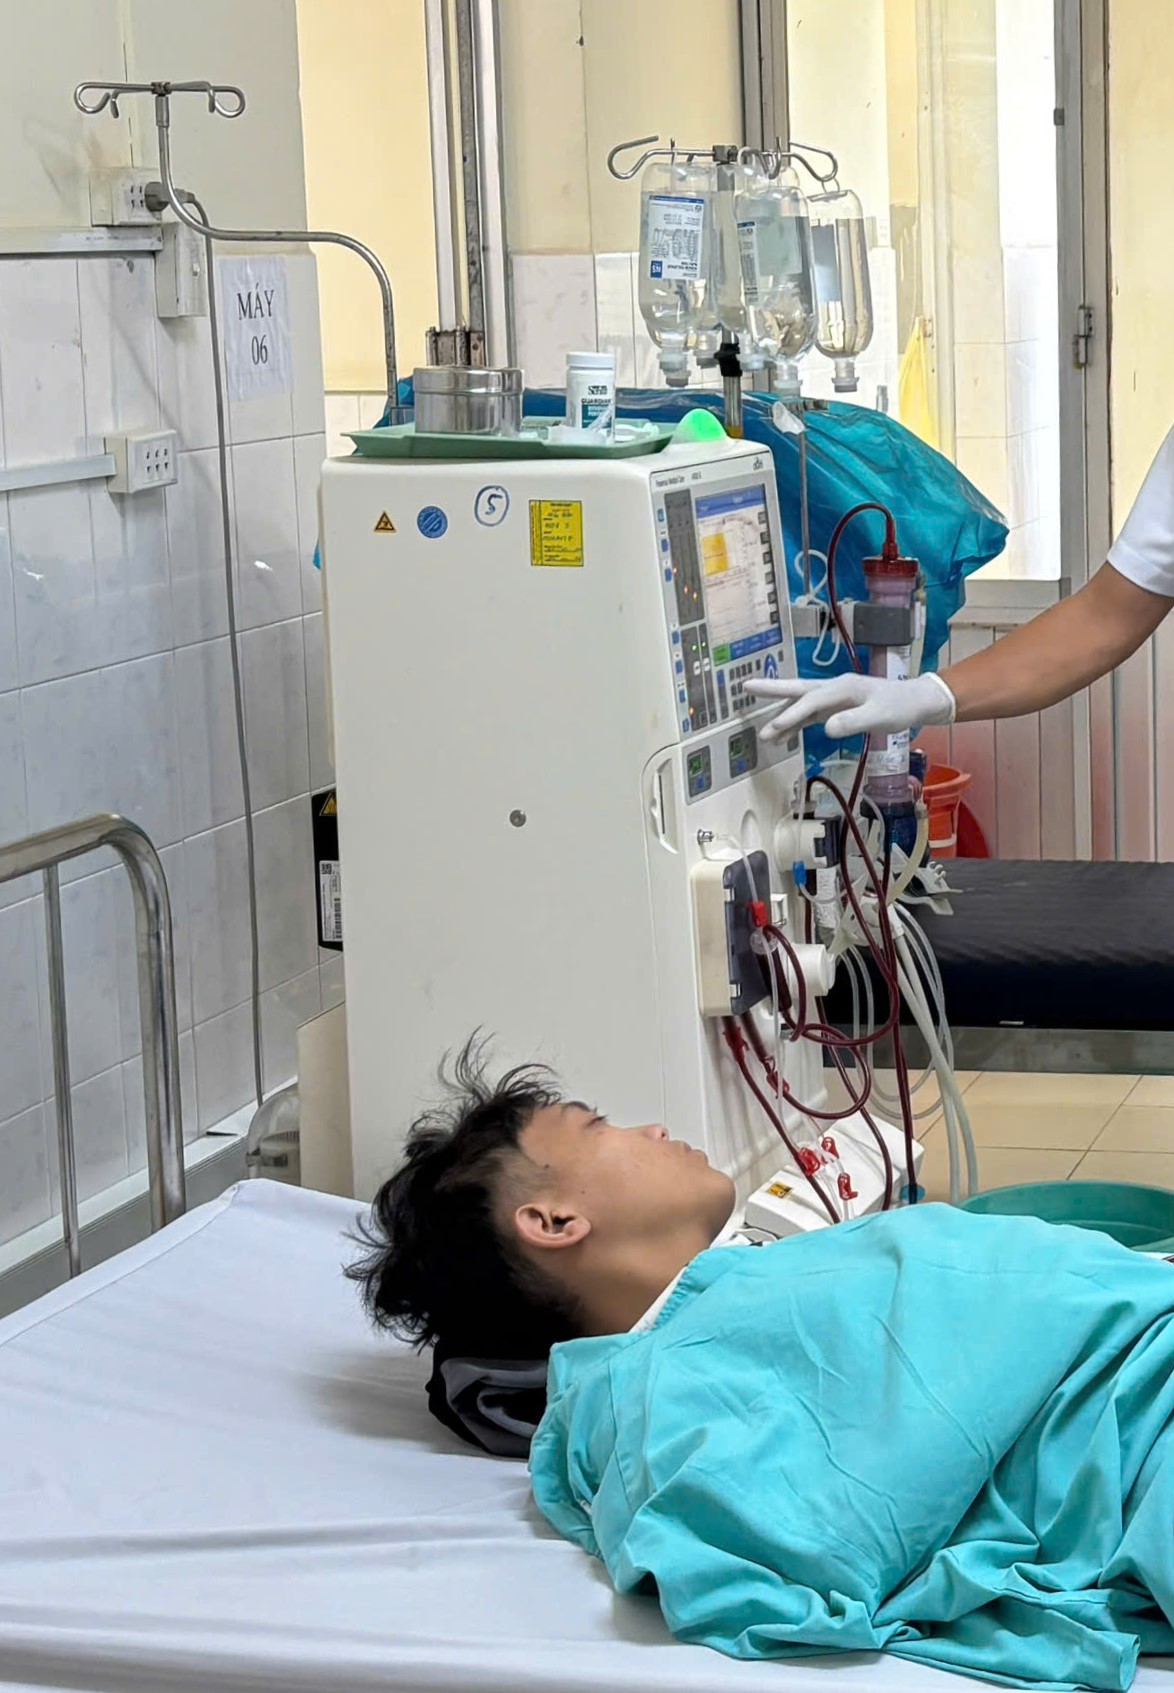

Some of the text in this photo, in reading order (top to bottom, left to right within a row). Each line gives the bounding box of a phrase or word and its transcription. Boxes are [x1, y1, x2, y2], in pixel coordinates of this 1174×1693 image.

[237, 282, 274, 320] MÁY
[251, 335, 268, 365] 06
[485, 493, 503, 515] 5
